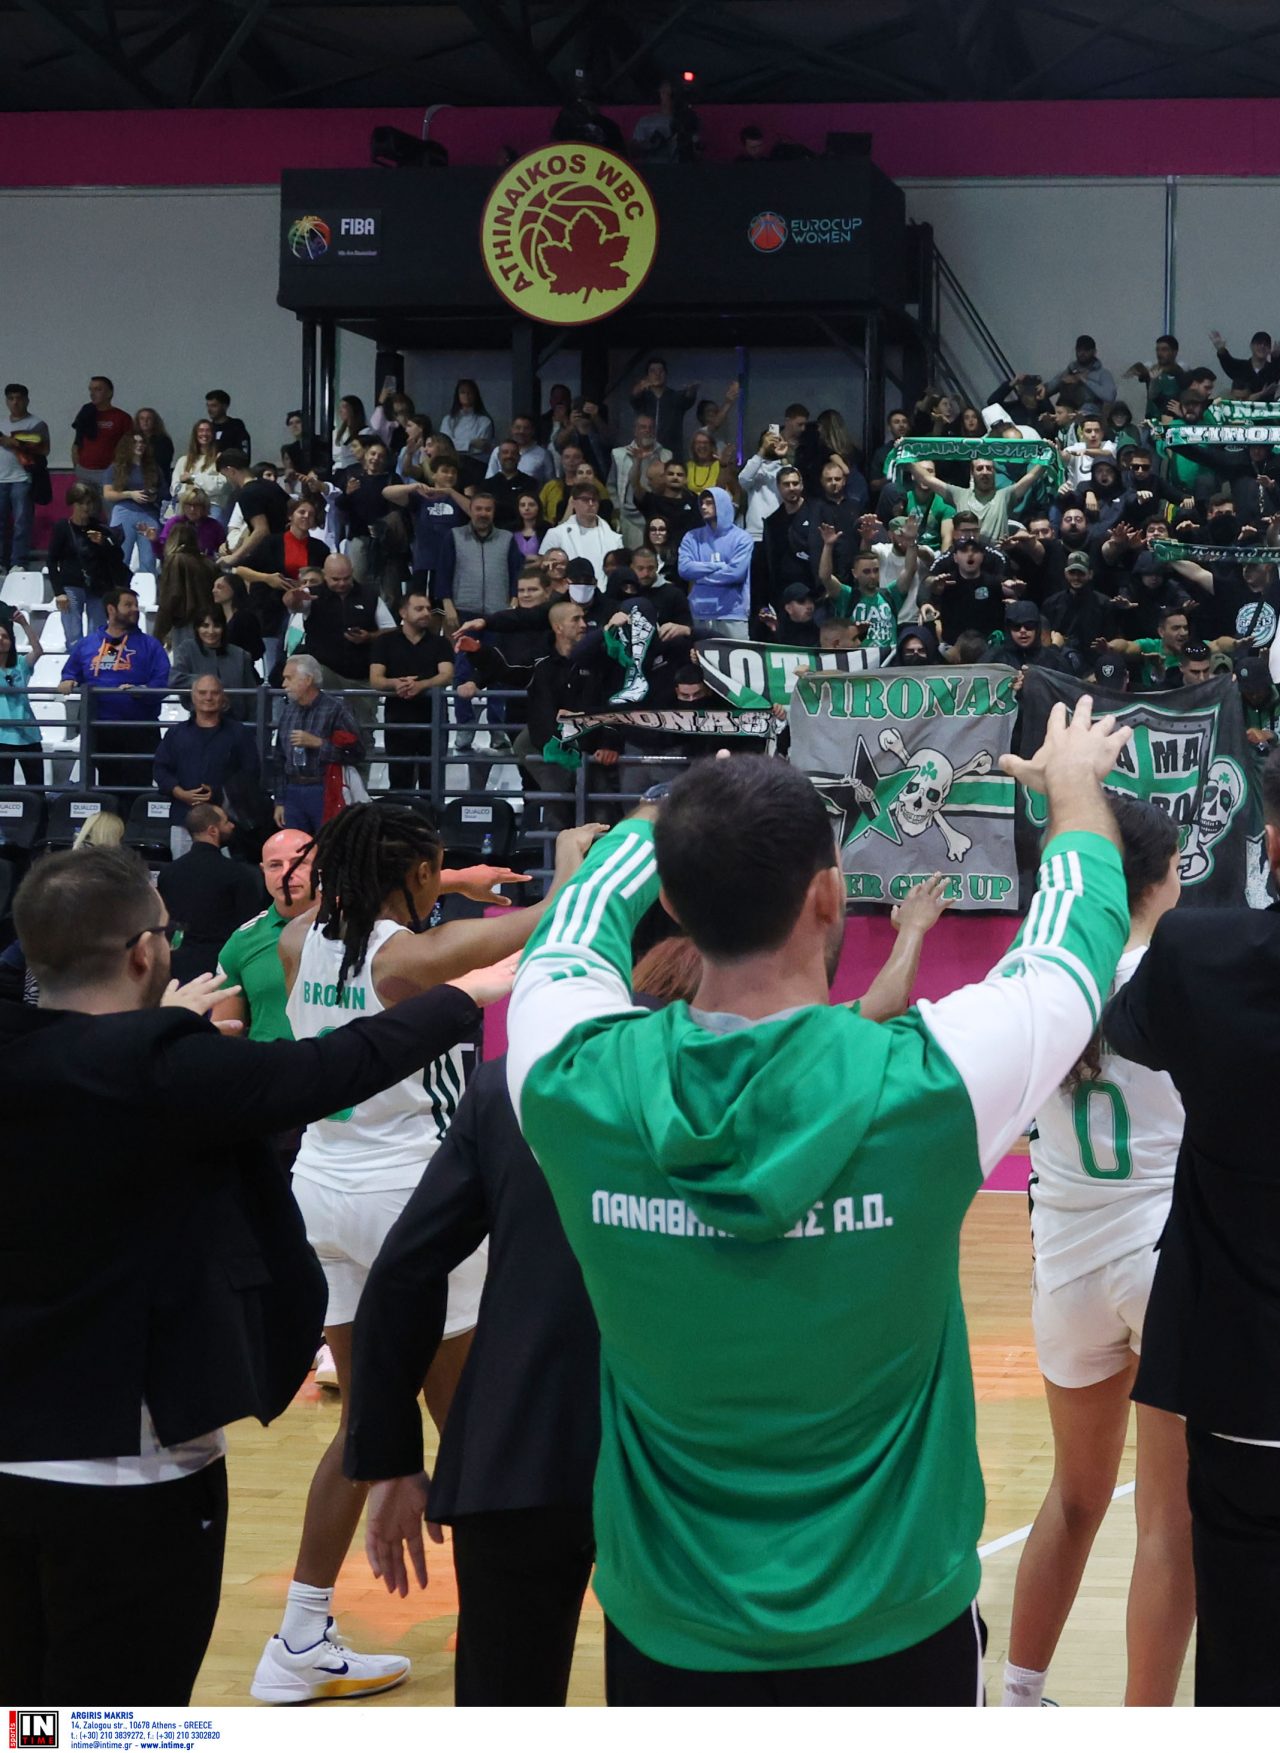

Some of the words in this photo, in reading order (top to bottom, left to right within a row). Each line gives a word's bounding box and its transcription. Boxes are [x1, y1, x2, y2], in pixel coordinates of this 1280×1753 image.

[340, 218, 375, 235] FIBA
[492, 154, 586, 293] ATHINAIKOS
[595, 160, 644, 221] WBC
[791, 217, 862, 231] EUROCUP
[791, 231, 852, 243] WOMEN
[796, 676, 1018, 720] VIRONAS
[889, 875, 961, 901] GE
[969, 874, 1012, 901] UP
[1072, 1080, 1133, 1180] 0
